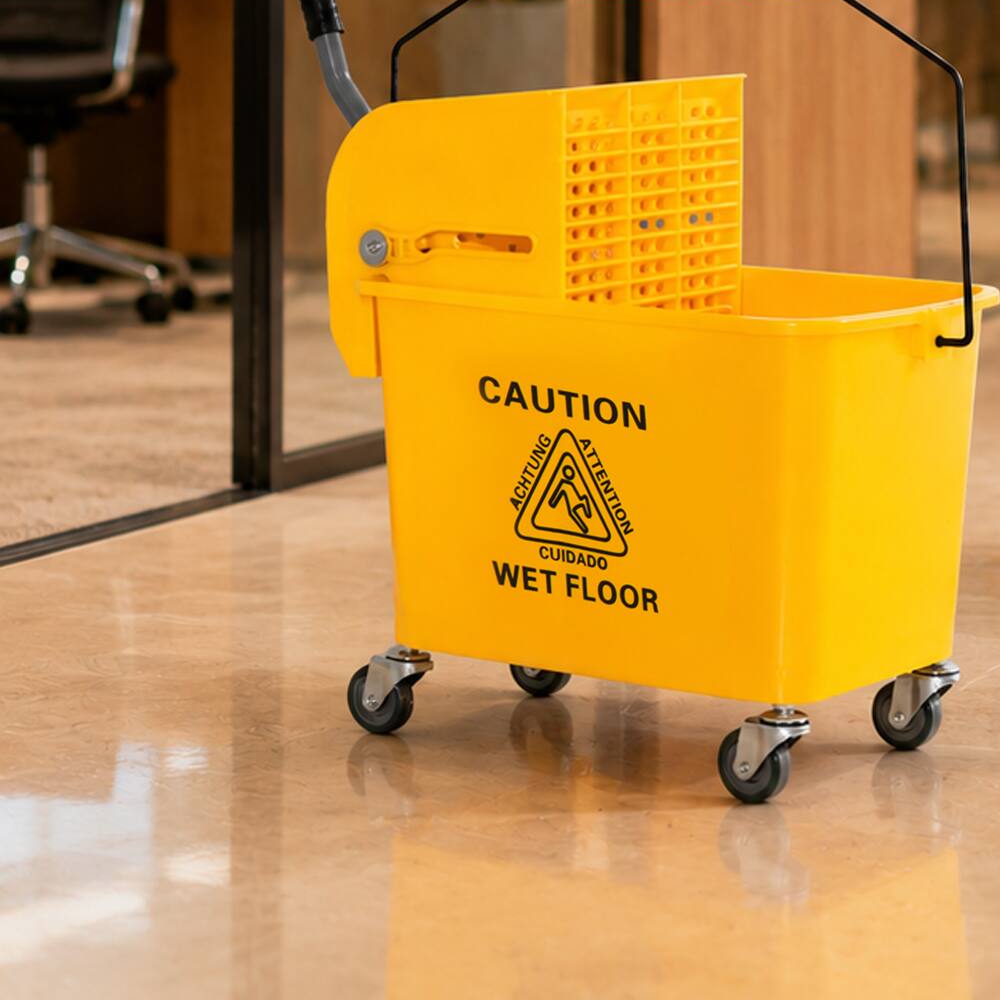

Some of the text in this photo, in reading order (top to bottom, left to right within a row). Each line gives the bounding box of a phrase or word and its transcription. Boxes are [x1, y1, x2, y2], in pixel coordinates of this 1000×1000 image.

[478, 375, 647, 431] CAUTION
[509, 433, 552, 511] ACHTUNG
[579, 437, 634, 535] ATTENTION
[539, 546, 608, 570] CUIDADO
[492, 560, 659, 613] WET FLOOR
